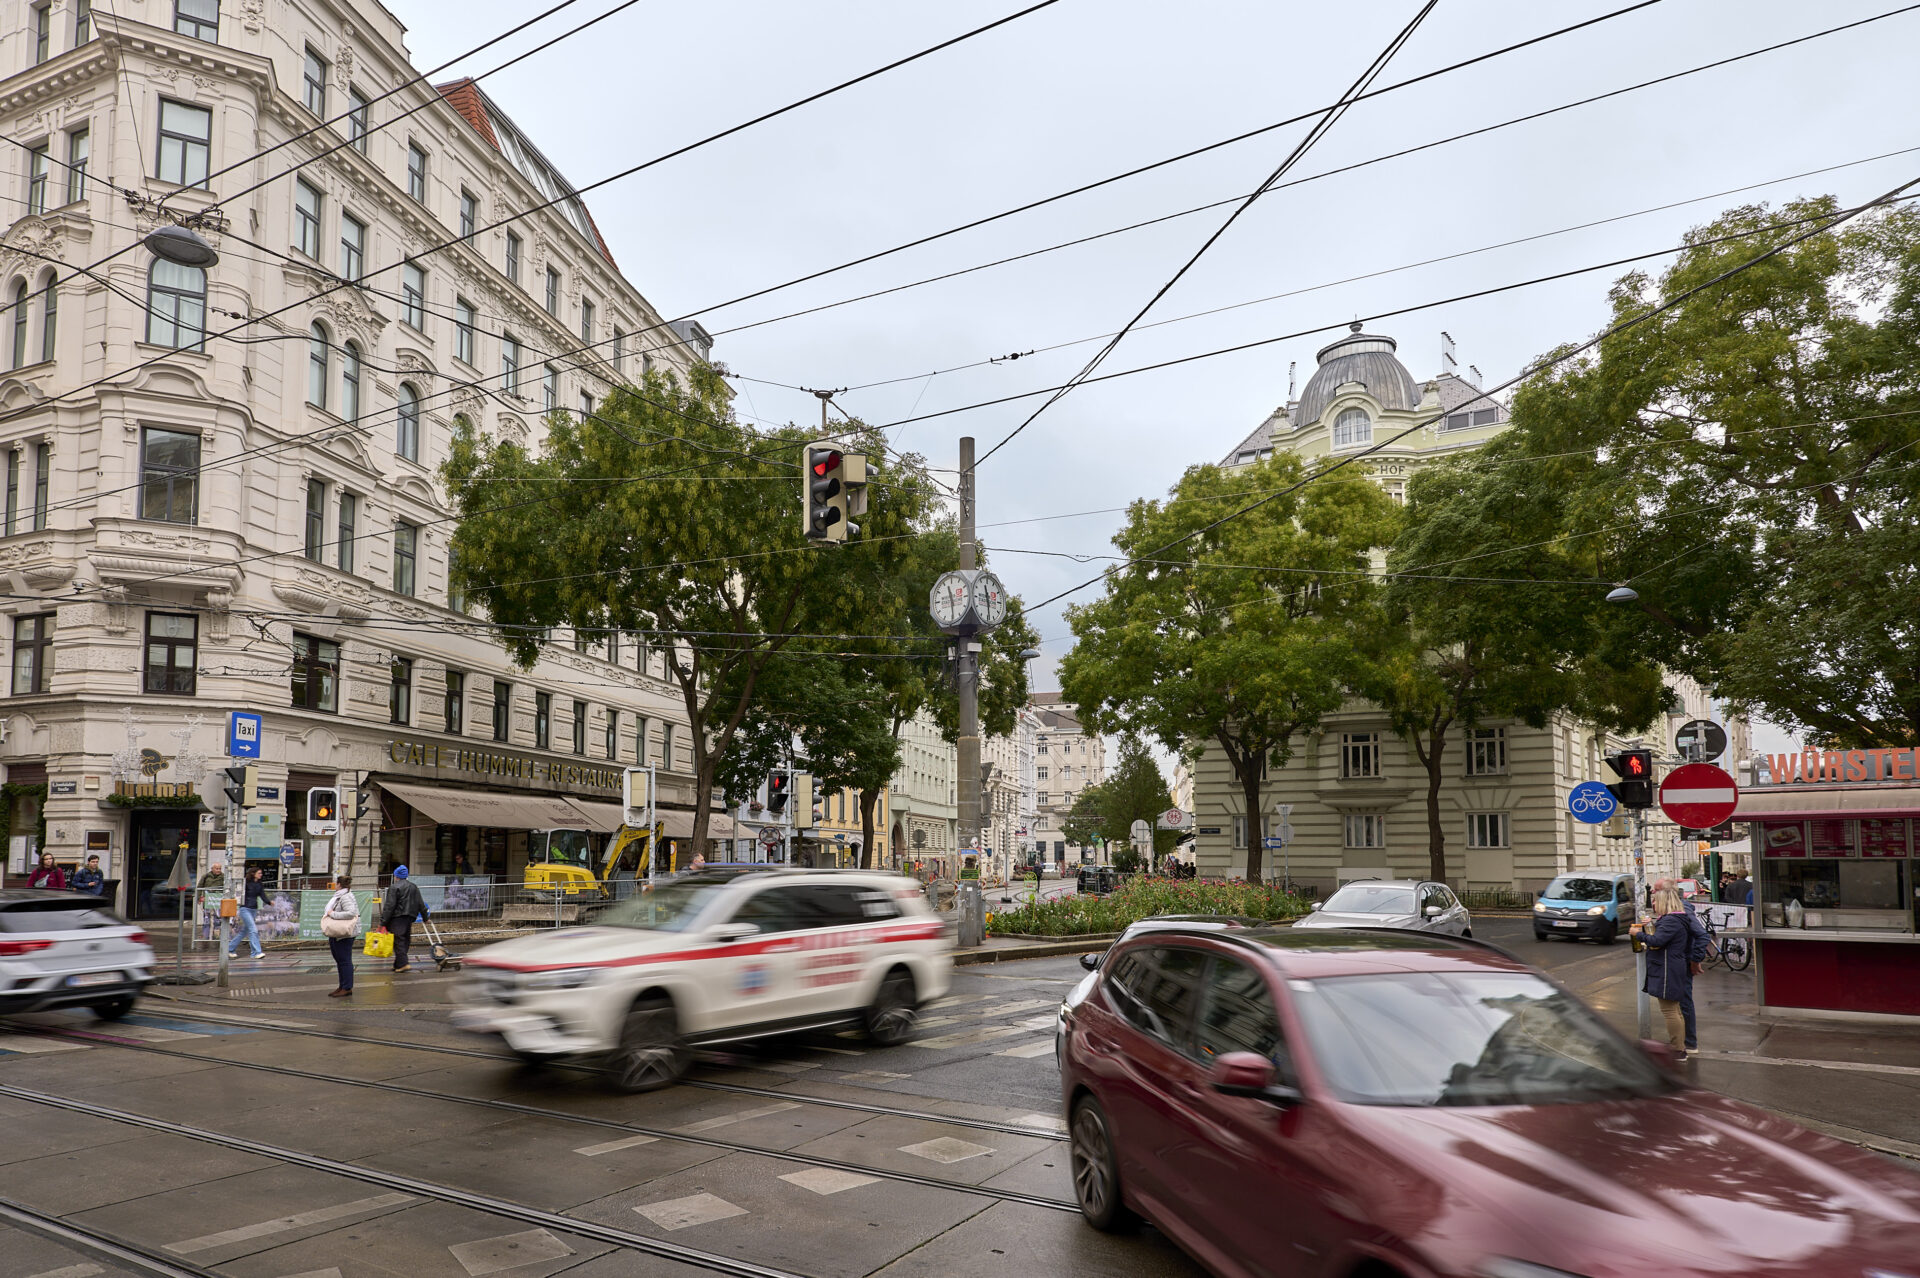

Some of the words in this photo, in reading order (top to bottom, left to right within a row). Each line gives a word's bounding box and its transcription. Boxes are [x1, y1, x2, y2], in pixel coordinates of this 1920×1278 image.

[238, 722, 255, 736] Taxi
[390, 740, 449, 769] CAFE
[114, 780, 194, 798] Hummel
